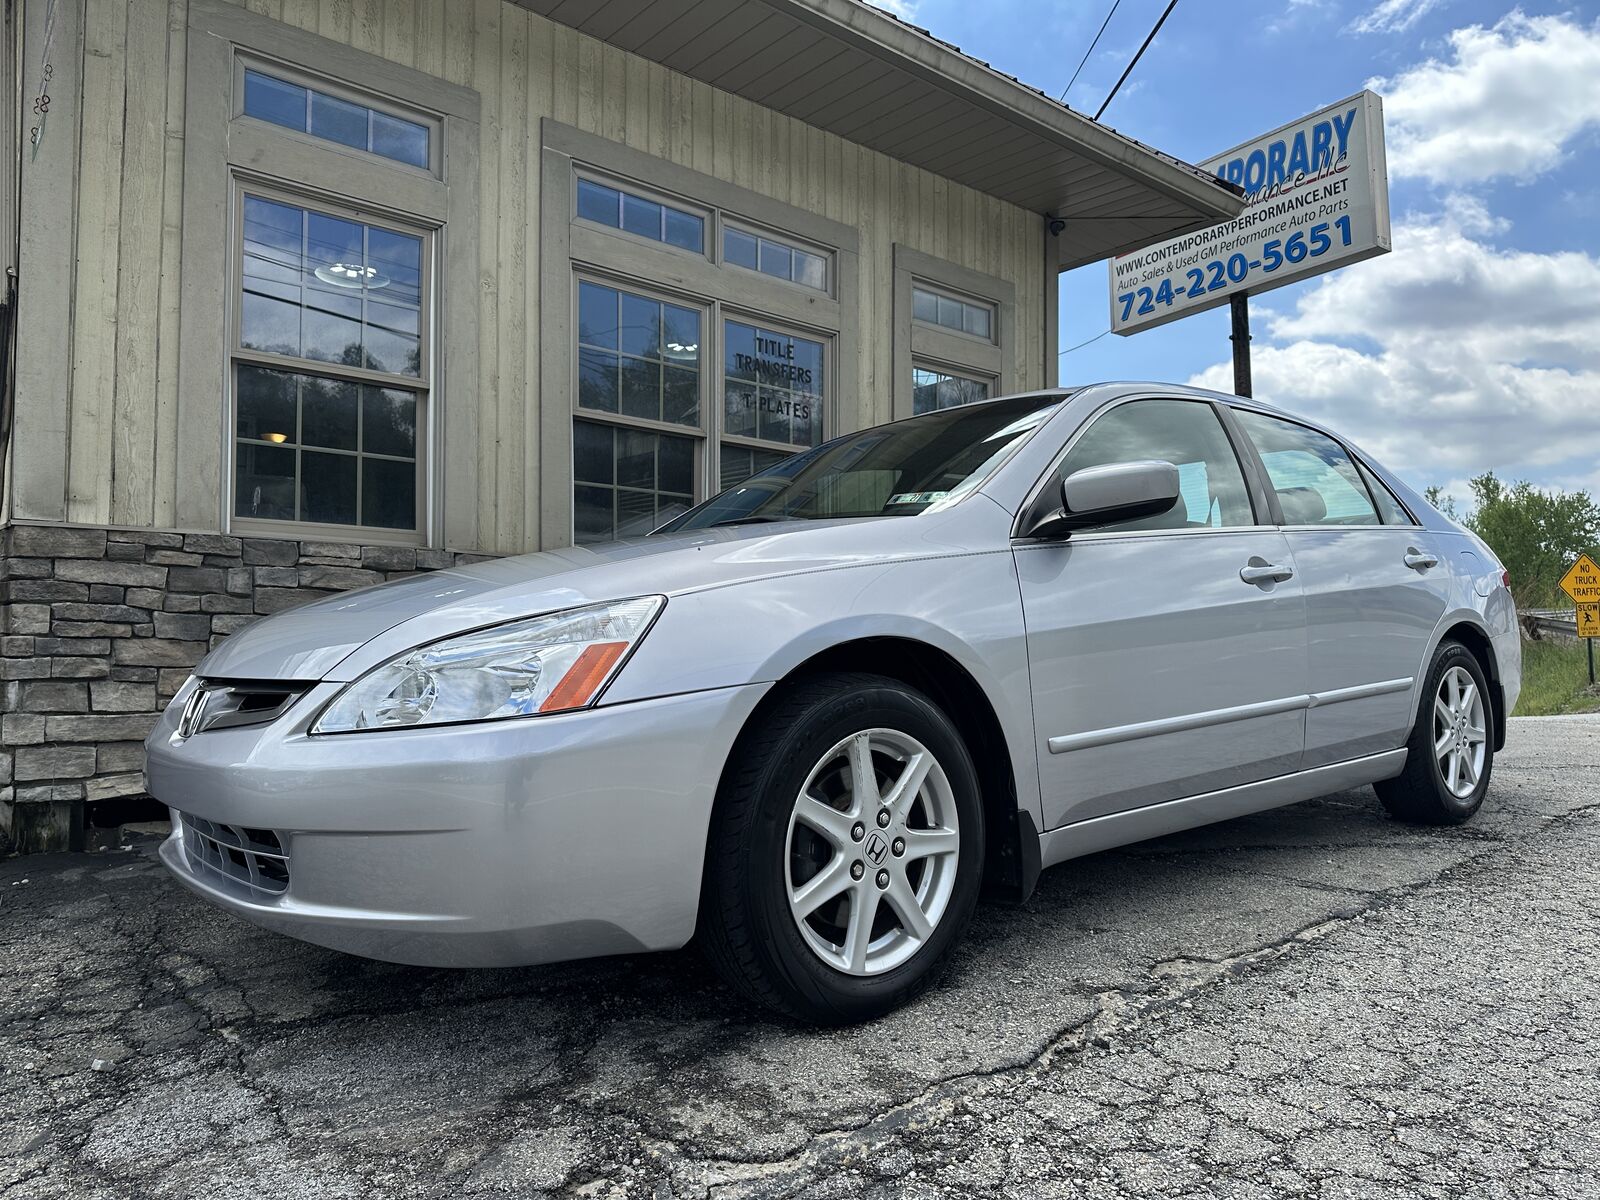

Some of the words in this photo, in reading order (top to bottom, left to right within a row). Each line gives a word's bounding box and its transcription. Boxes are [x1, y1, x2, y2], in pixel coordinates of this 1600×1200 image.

[1116, 178, 1348, 277] WWW.CONTEMPORARYPERFORMANCE.NET
[1118, 277, 1138, 291] Auto
[1142, 266, 1164, 282] Sales
[1166, 261, 1174, 273] &
[1176, 251, 1199, 269] Used
[1200, 245, 1218, 260] GM
[1220, 221, 1287, 253] Performance
[1289, 211, 1316, 229] Auto
[1318, 199, 1349, 218] Parts
[1118, 214, 1352, 322] 724-220-5651
[756, 337, 795, 360] TITLE
[735, 352, 812, 384] TRANSFERS
[1575, 575, 1597, 585] TRUCK
[1580, 564, 1590, 573] NO
[1577, 604, 1598, 612] SLOW
